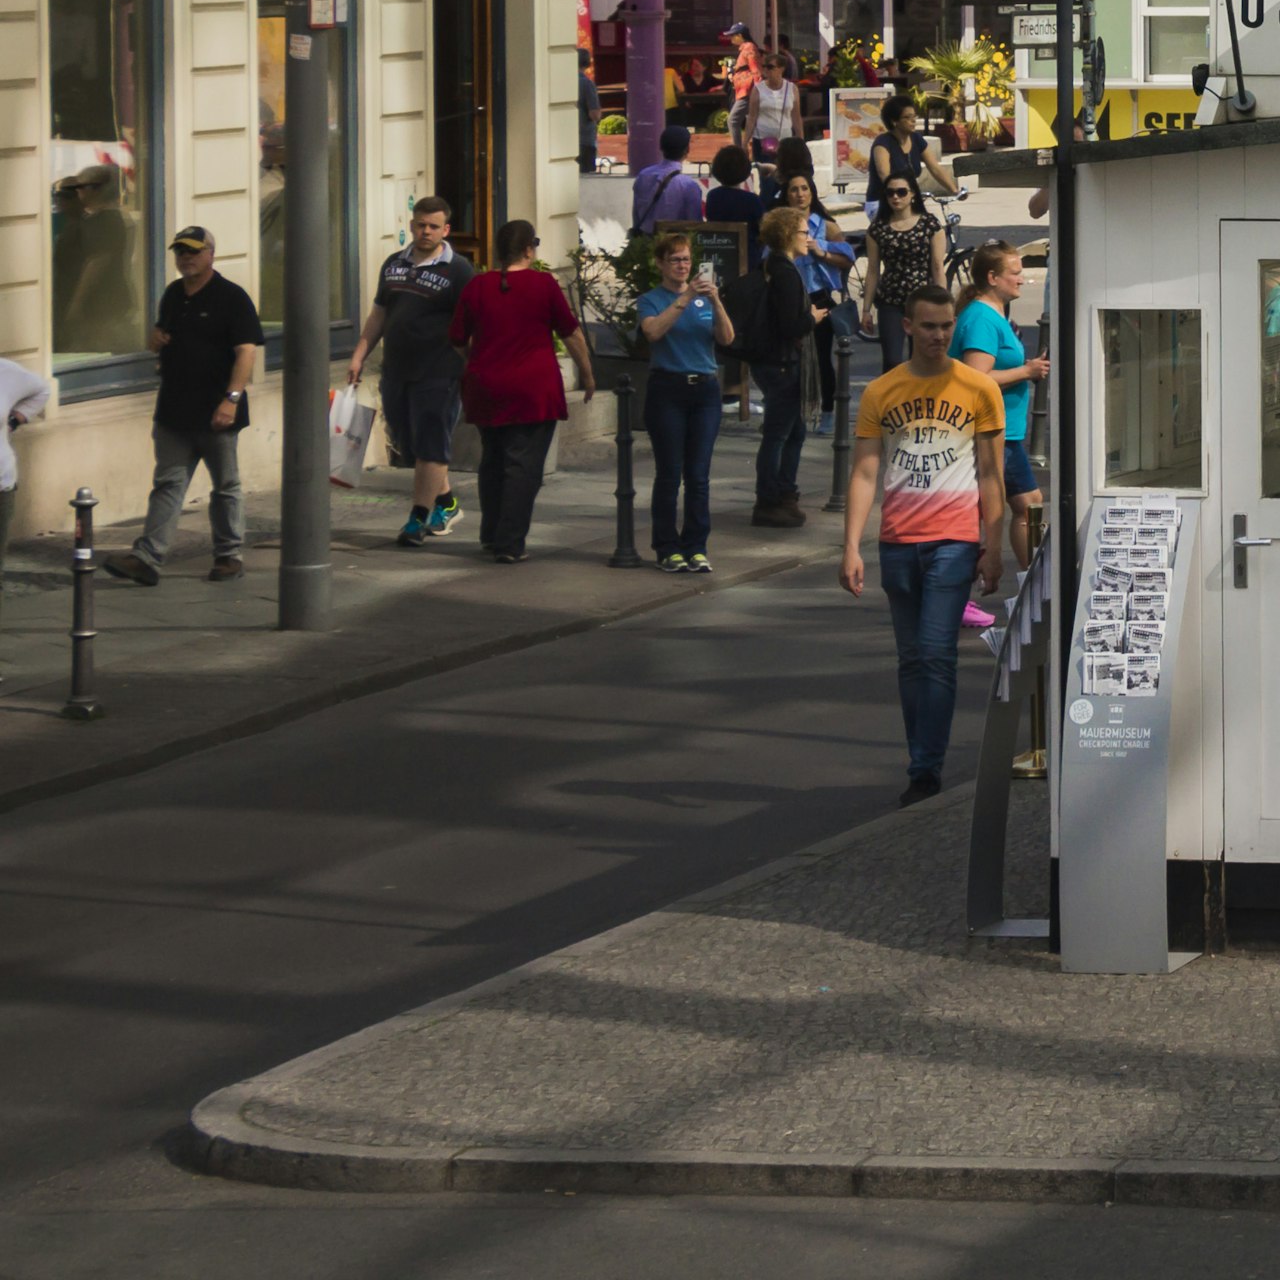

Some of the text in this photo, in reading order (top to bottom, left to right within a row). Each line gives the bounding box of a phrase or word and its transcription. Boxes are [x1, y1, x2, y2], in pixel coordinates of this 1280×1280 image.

[384, 267, 450, 288] CAMP DAVID
[881, 397, 975, 435] SUPERDRY
[1079, 727, 1152, 739] MAUERMUSEUM
[1079, 740, 1150, 748] CHECKPOINT CHARLIE
